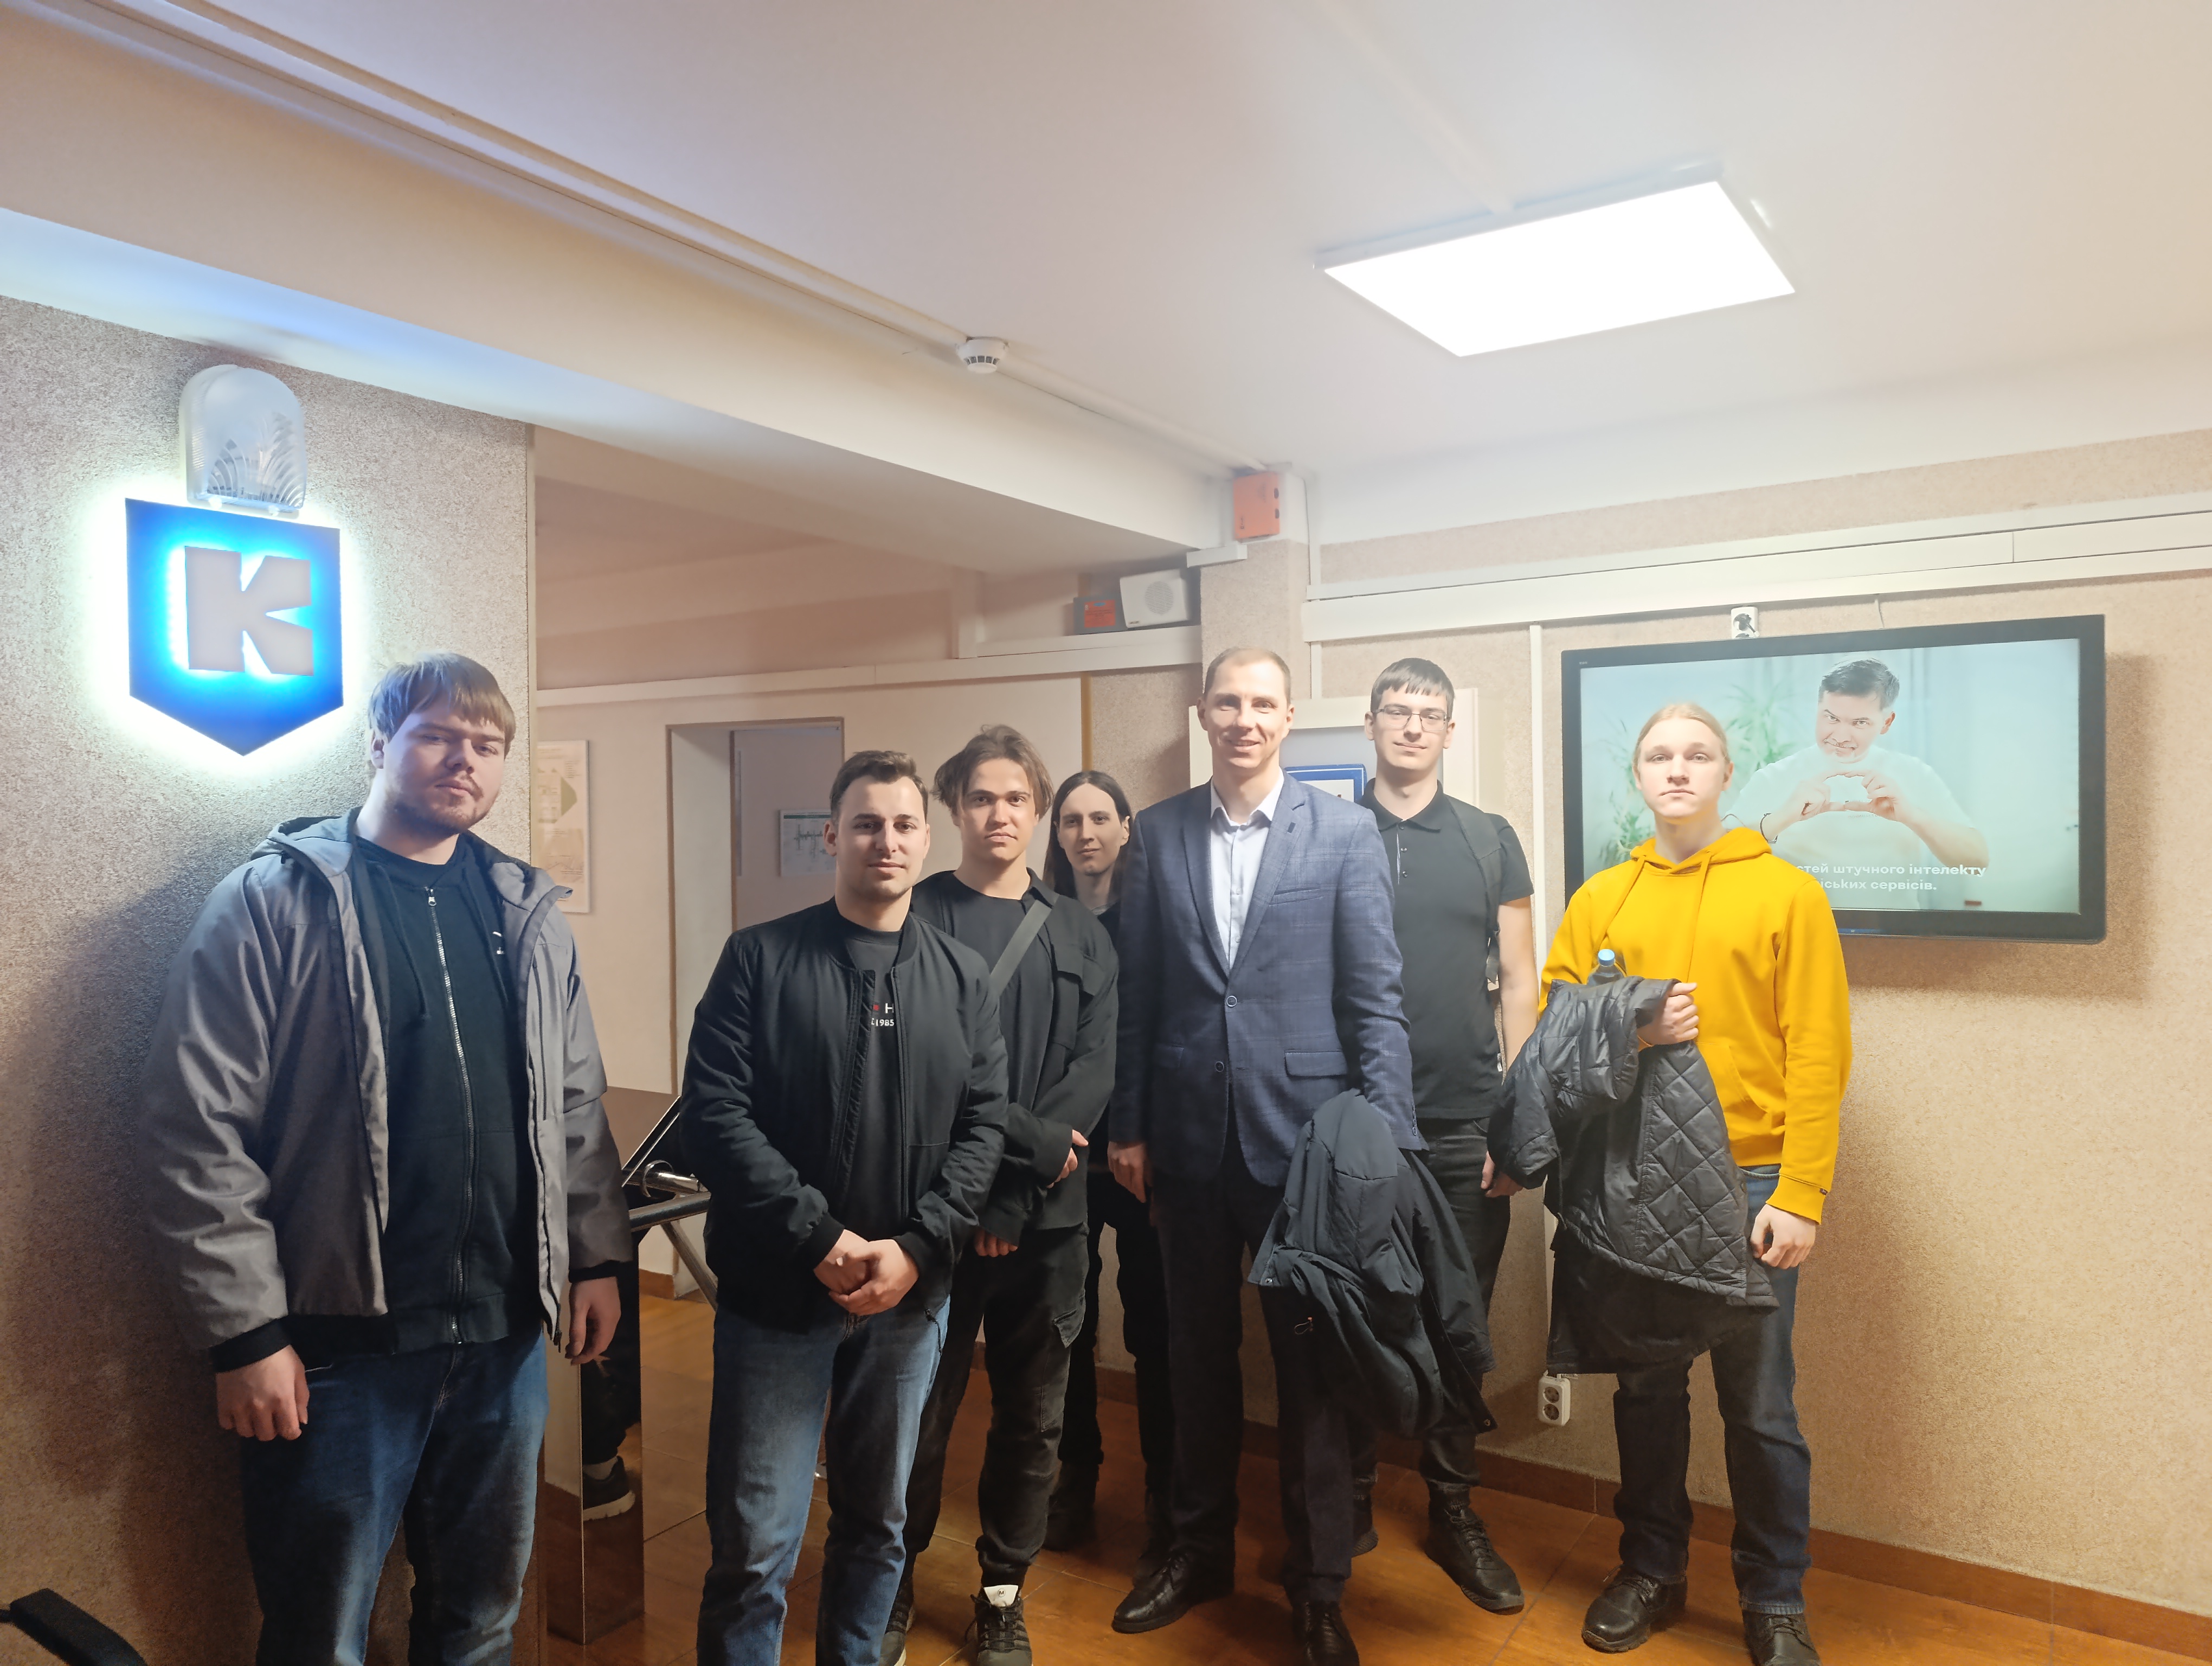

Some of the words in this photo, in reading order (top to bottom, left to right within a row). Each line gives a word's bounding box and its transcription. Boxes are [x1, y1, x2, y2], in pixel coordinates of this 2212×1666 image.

[1833, 866, 1905, 876] штучного
[1909, 863, 1987, 877] інтелекту
[1818, 877, 1867, 889] іських
[1870, 879, 1937, 892] сервісів.
